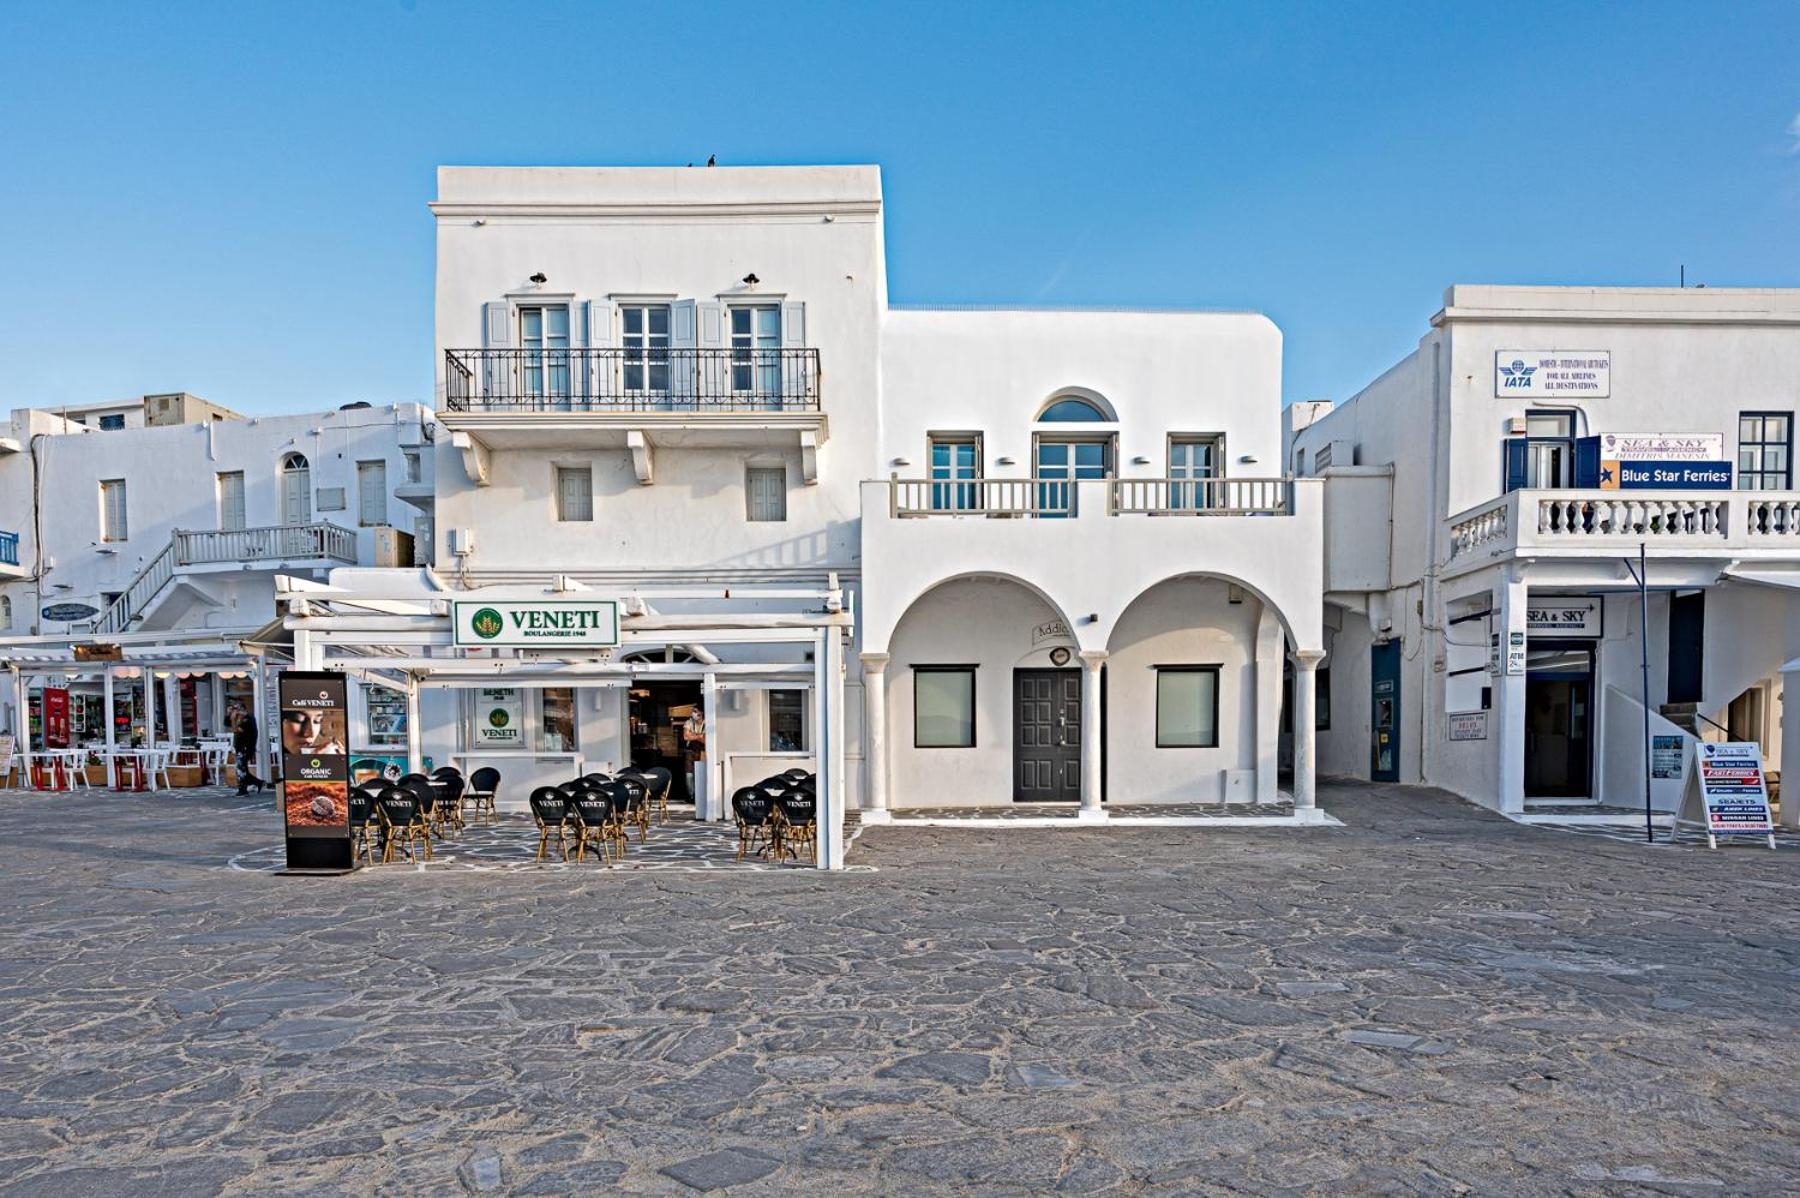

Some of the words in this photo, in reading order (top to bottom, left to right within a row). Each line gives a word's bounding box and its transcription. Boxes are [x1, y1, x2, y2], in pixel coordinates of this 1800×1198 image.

[1504, 377, 1532, 387] IATA
[1676, 439, 1705, 447] SKY
[1621, 469, 1650, 482] Blue
[1654, 469, 1680, 482] Star
[1683, 469, 1728, 482] Ferries
[510, 610, 600, 628] VENETI
[1527, 610, 1548, 621] SEA
[1562, 610, 1586, 621] SKY
[482, 729, 517, 737] VENETI
